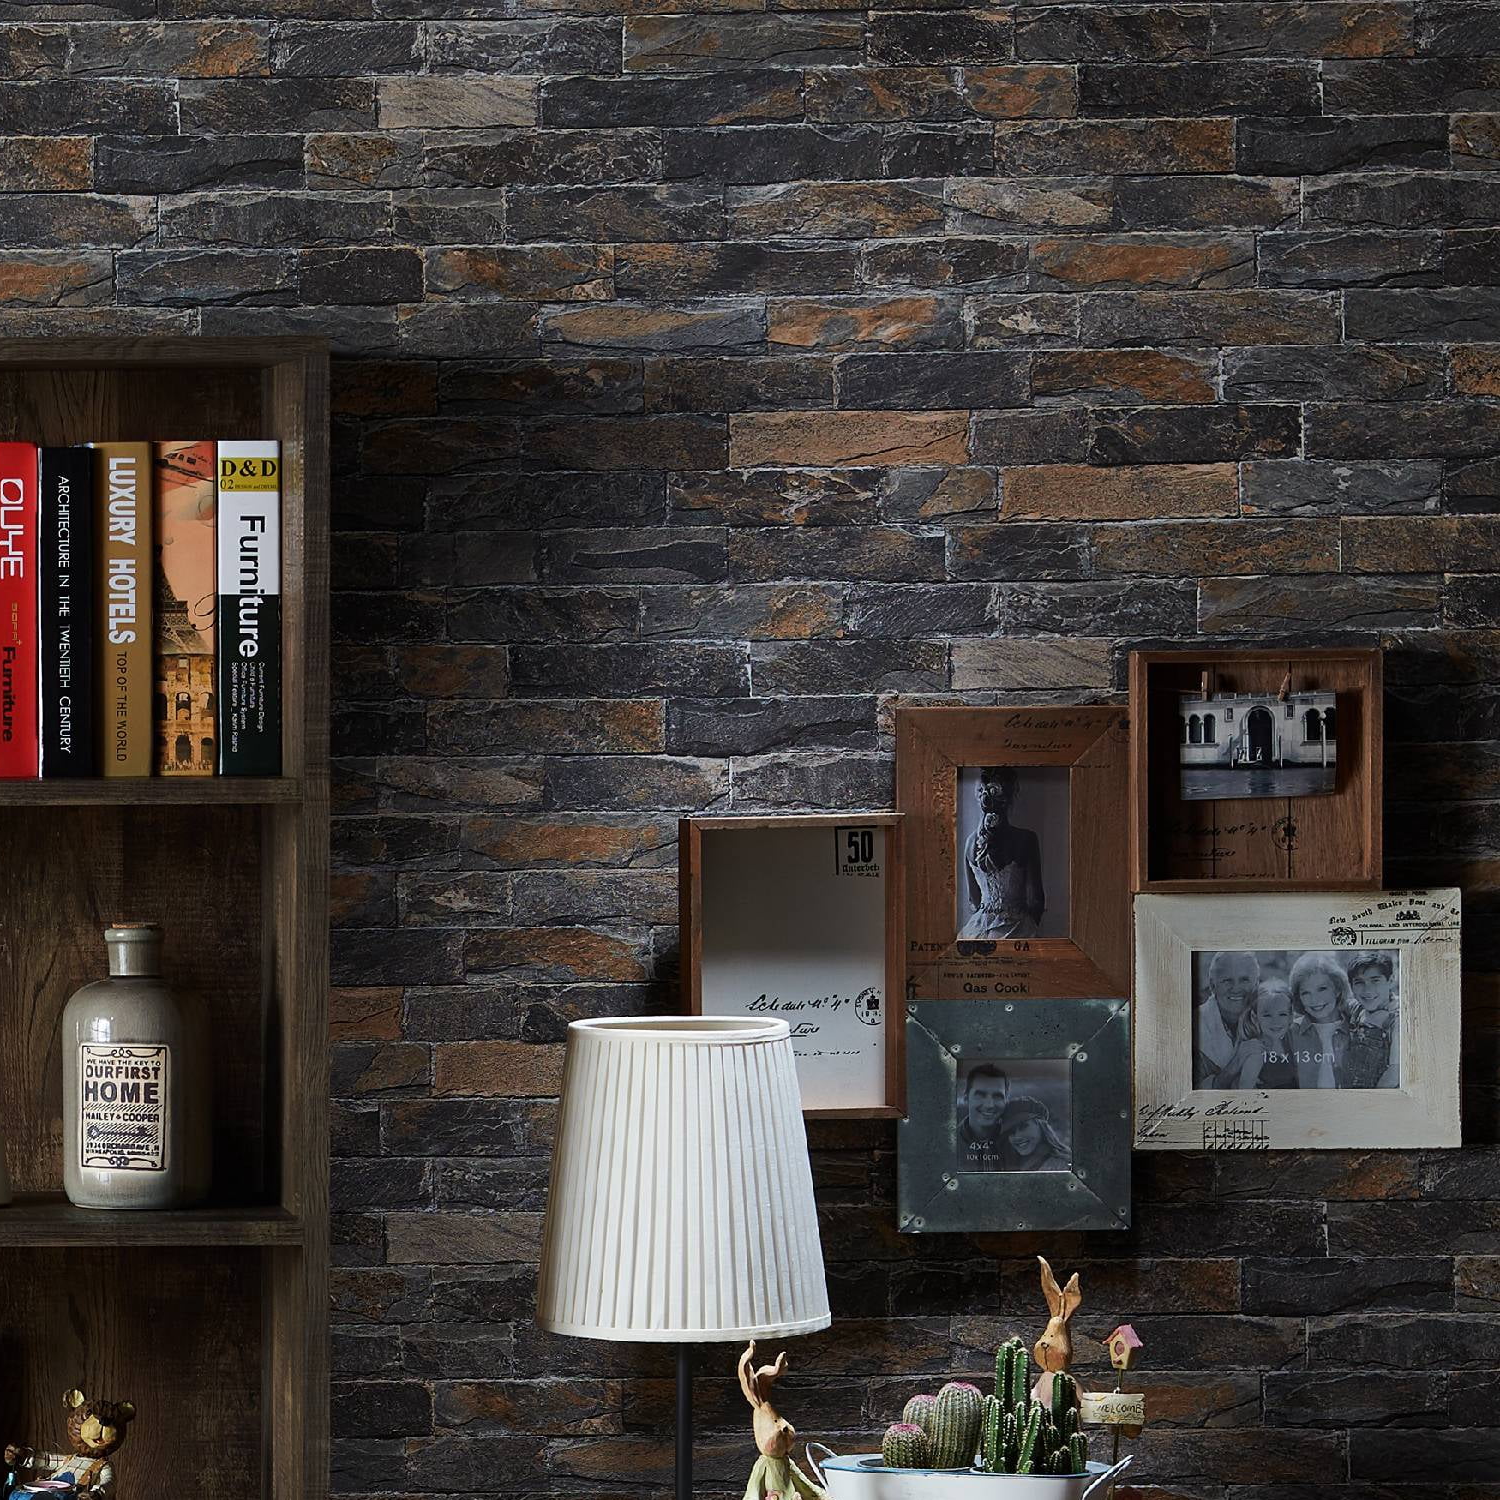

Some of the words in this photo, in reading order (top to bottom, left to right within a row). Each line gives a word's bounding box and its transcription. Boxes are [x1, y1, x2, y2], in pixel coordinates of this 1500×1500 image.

[221, 459, 236, 476] D
[240, 459, 258, 476] &
[261, 460, 277, 476] D
[108, 456, 136, 546] LUXURY
[58, 476, 70, 568] ARCHITECTURE
[58, 574, 70, 588] IN
[238, 516, 266, 659] Furniture
[58, 596, 70, 617] THE
[108, 558, 136, 645] HOTELS
[58, 624, 71, 688] TWENTIETH
[116, 651, 128, 674] TOP
[2, 646, 17, 742] Furniture
[116, 676, 128, 692] OF
[116, 695, 128, 717] THE
[59, 696, 71, 754] CENTURY
[116, 720, 128, 762] WORLD
[963, 982, 988, 994] Gas
[1261, 1050, 1278, 1064] 18
[1280, 1054, 1290, 1064] x
[1293, 1050, 1310, 1063] 13
[1314, 1052, 1336, 1063] cm
[84, 1080, 159, 1104] HOME
[85, 1112, 115, 1121] HAILEY
[122, 1113, 160, 1123] COOPER
